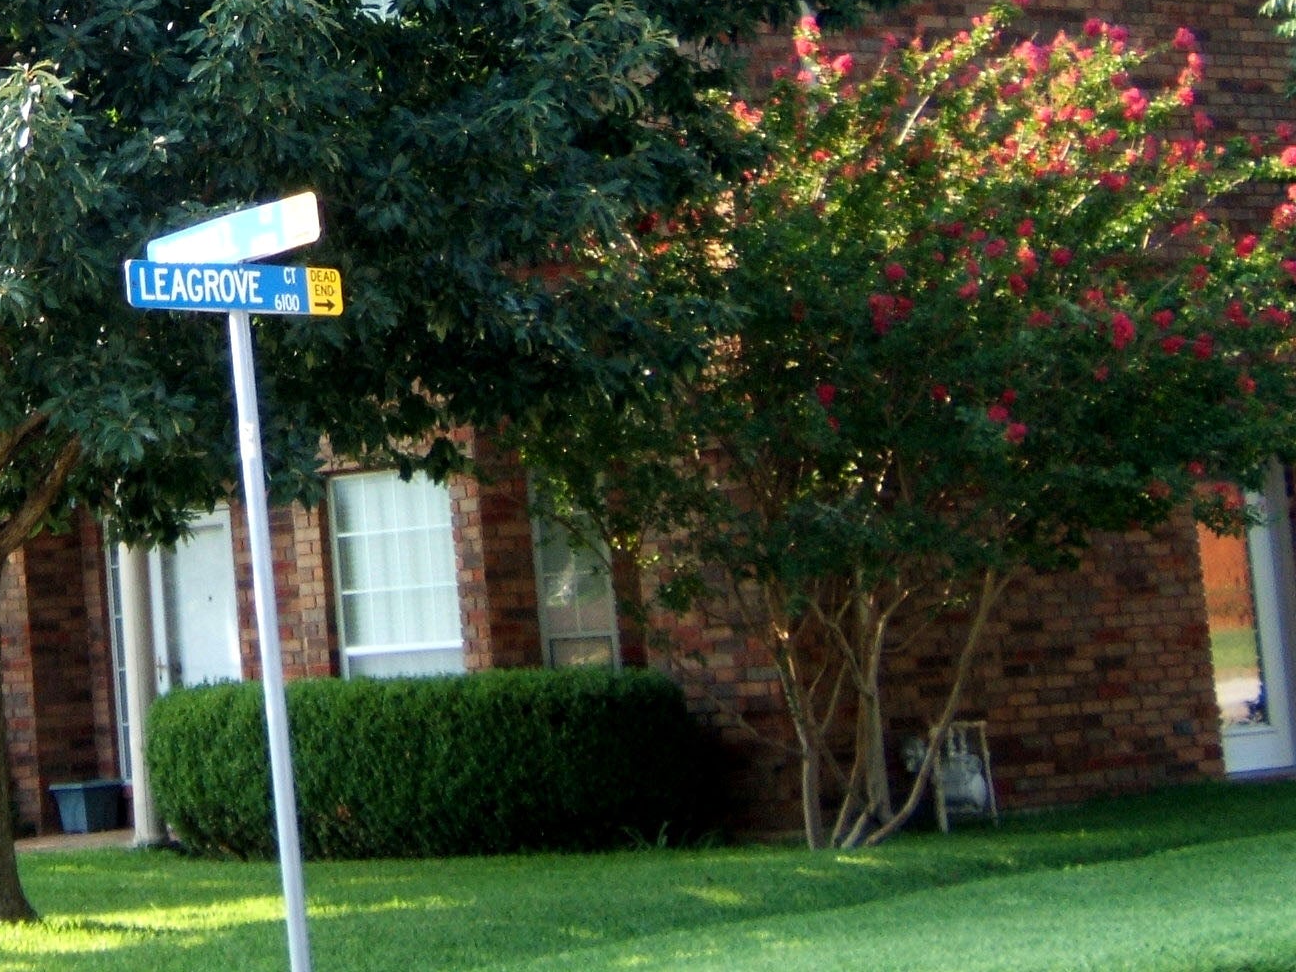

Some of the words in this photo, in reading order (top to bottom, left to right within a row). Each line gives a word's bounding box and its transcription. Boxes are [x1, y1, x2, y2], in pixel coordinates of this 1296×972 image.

[310, 270, 337, 283] DEAD
[139, 267, 263, 304] LEAGROVE
[284, 267, 297, 285] CT
[314, 284, 335, 296] END
[274, 294, 300, 312] 6100
